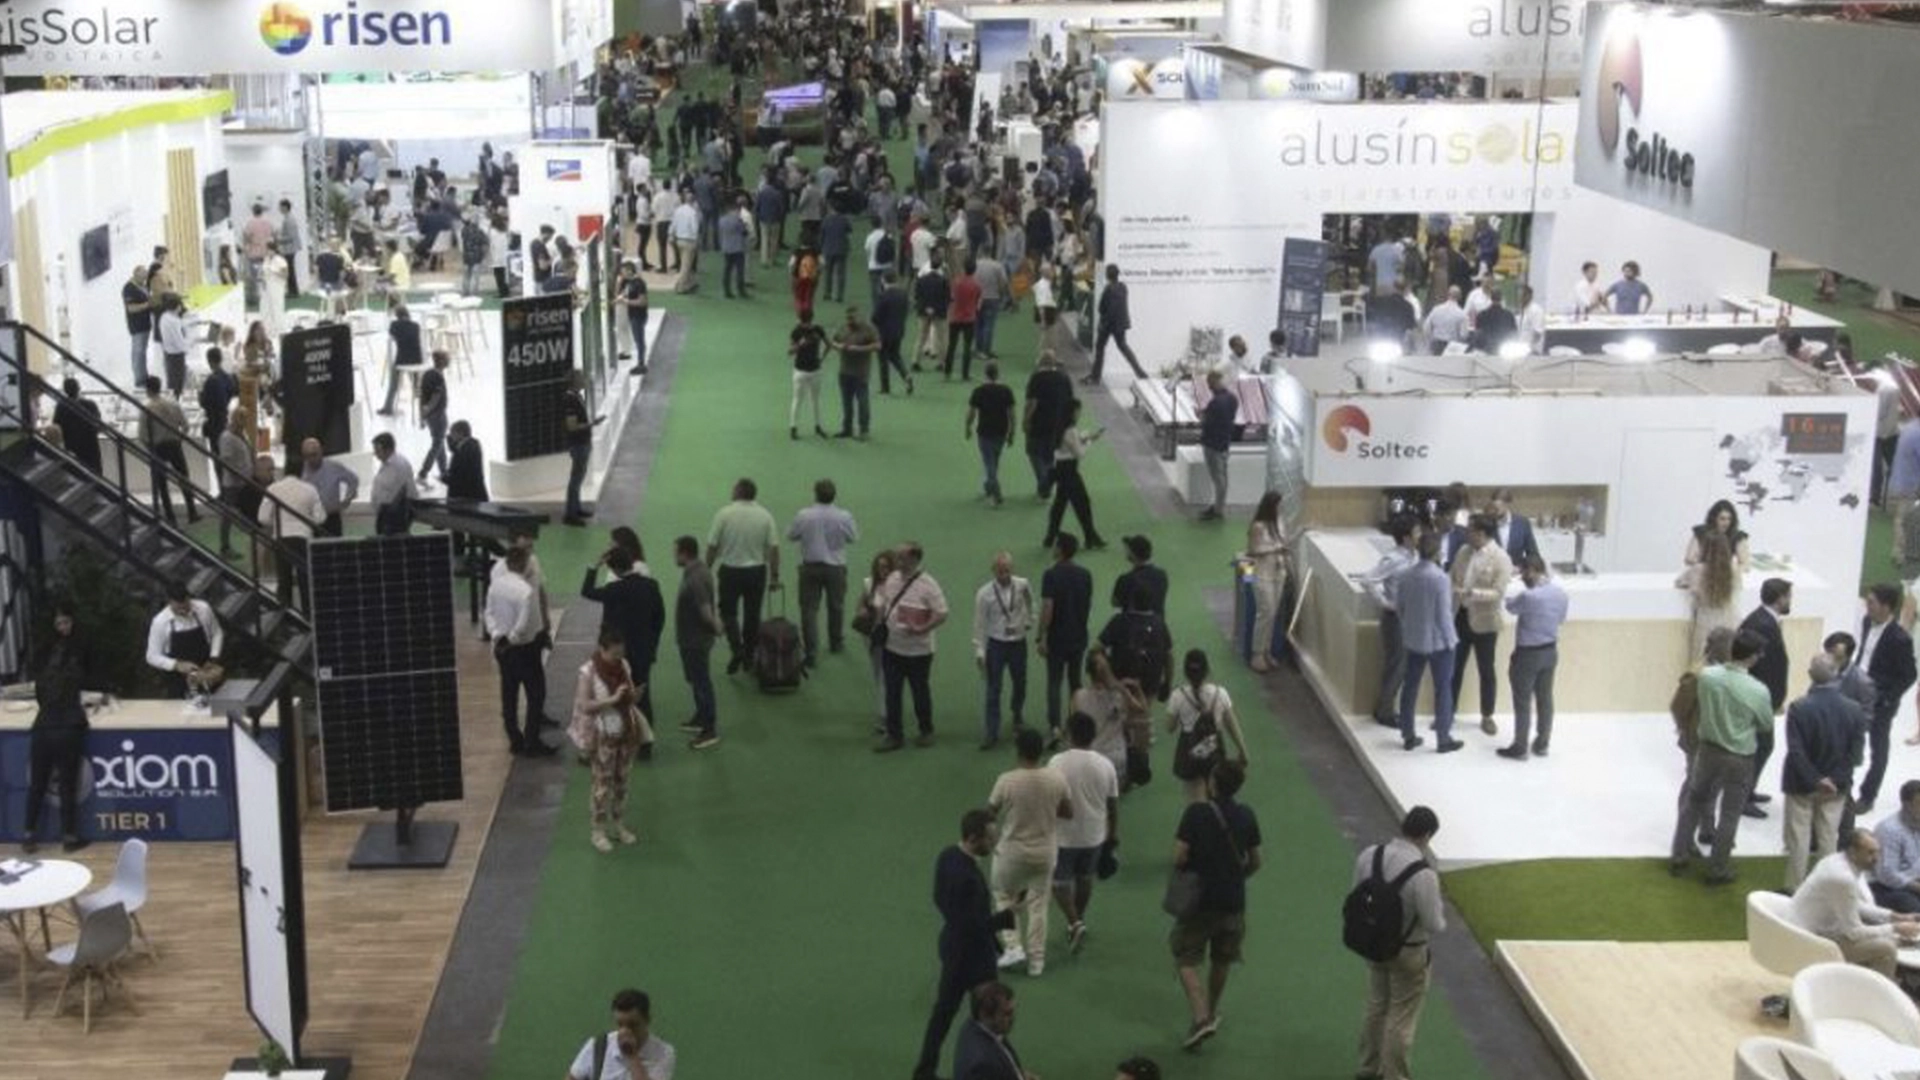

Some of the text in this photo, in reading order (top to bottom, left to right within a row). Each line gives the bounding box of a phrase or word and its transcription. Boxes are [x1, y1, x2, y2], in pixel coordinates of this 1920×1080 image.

[0, 7, 158, 46] isSolar
[322, 1, 451, 46] risen
[1624, 126, 1695, 188] Soltec
[507, 337, 570, 367] 450W
[1358, 441, 1429, 459] Soltec
[97, 812, 167, 831] TIER 1
